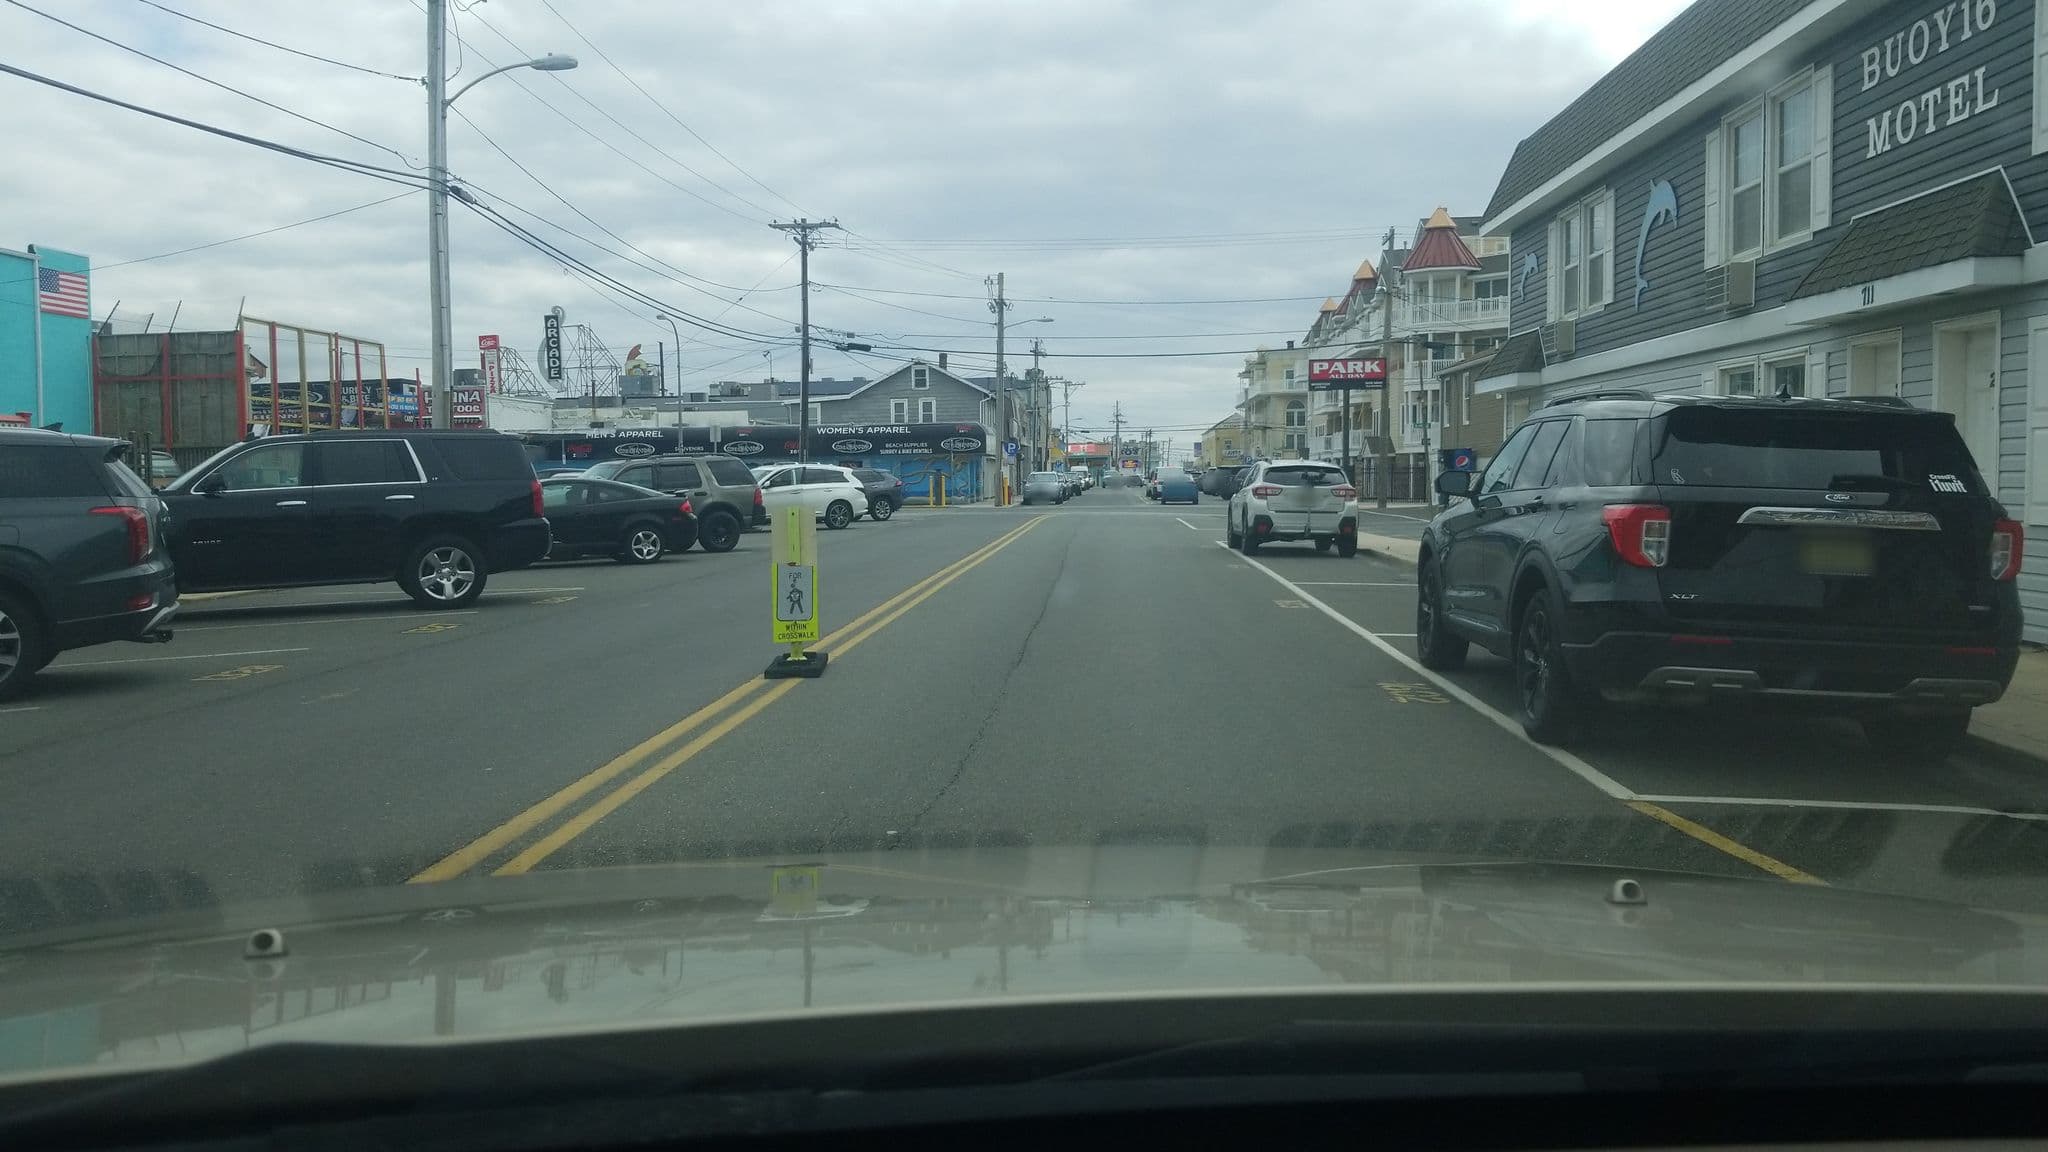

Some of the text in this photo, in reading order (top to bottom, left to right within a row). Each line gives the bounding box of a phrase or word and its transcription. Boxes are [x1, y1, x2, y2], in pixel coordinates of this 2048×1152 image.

[1861, 0, 1996, 92] BUOY16
[1866, 65, 1999, 159] MOTEL
[1861, 284, 1874, 306] 711
[546, 317, 560, 378] ARCADE
[1312, 359, 1382, 375] PARK
[618, 430, 665, 439] APPAREL
[816, 425, 911, 435] WOMEN'S APPAREL
[1007, 443, 1016, 453] P
[778, 632, 814, 640] CROSSWALK
